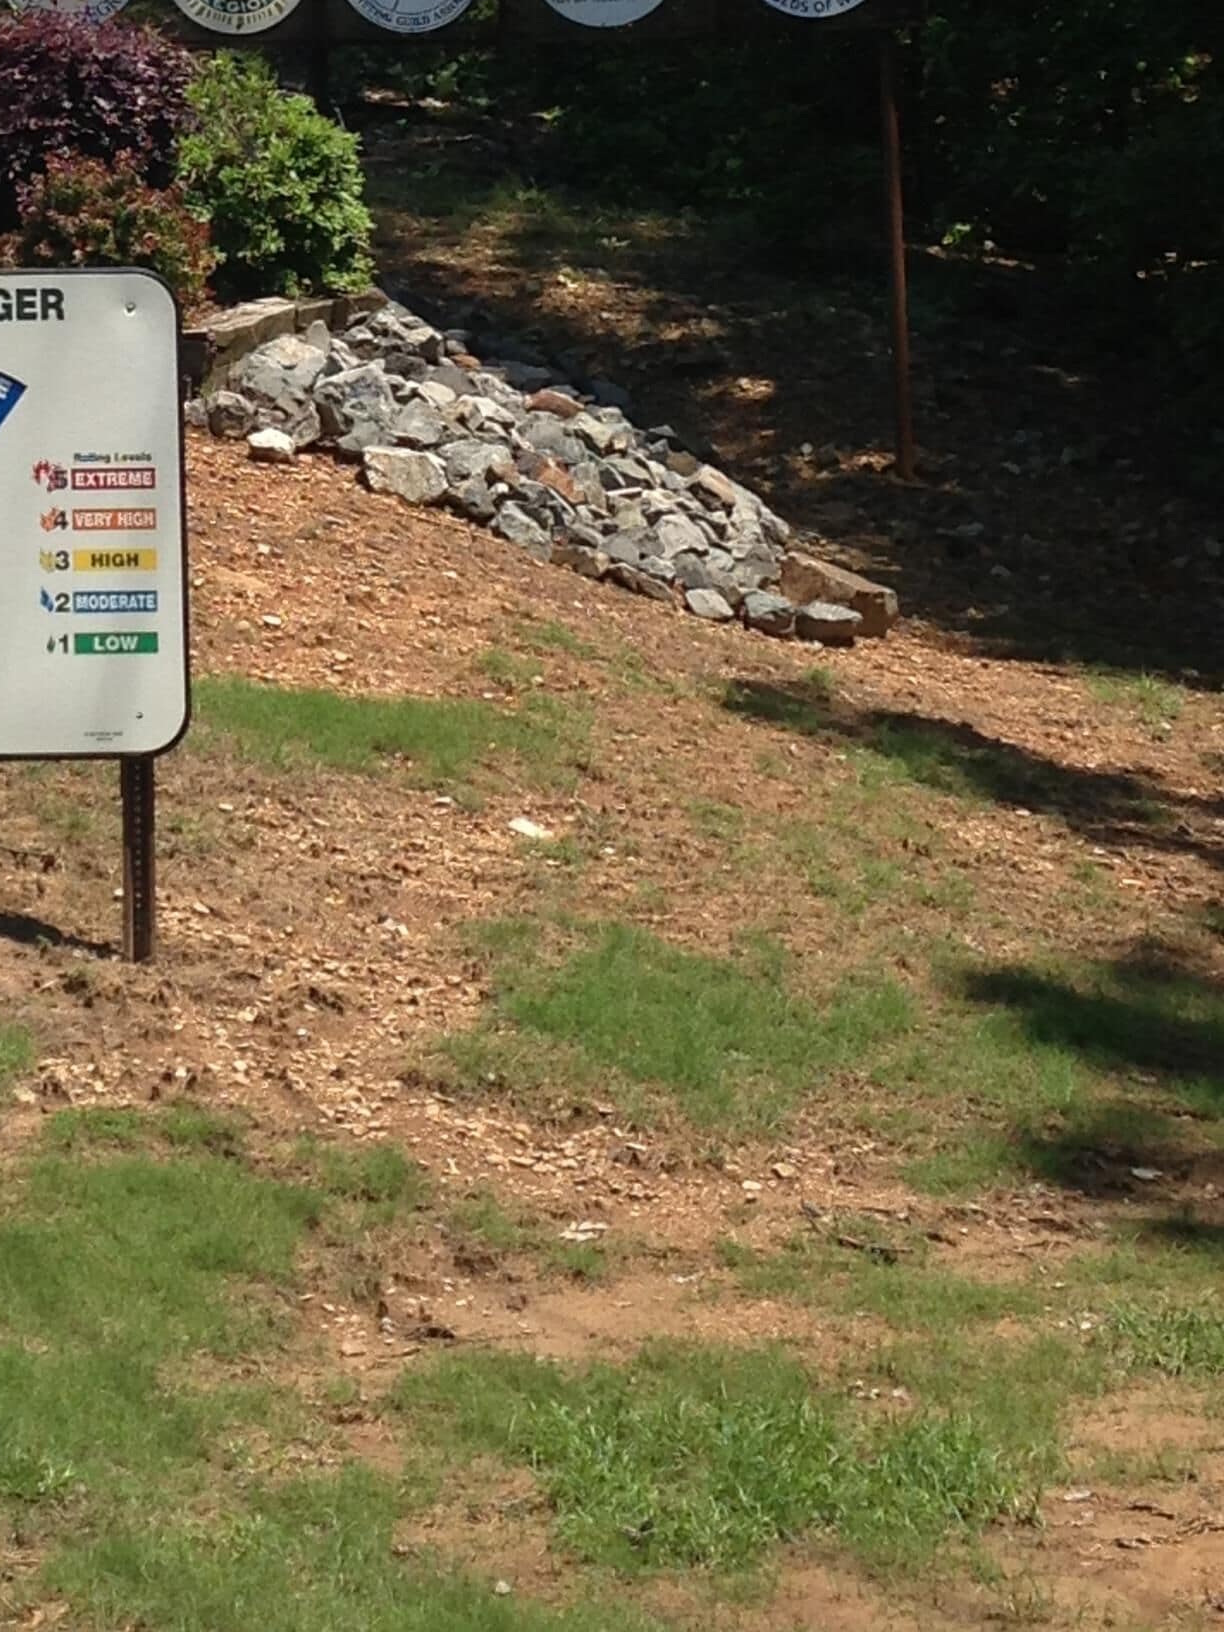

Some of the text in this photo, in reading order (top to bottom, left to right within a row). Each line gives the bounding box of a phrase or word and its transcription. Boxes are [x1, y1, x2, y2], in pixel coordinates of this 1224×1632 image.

[75, 471, 153, 487] EXTREME
[54, 510, 154, 530] 4 VERY HIGH
[55, 551, 140, 570] 3 HIGH
[55, 592, 156, 611] 2 MODERATE
[60, 635, 138, 654] 1 LOW
